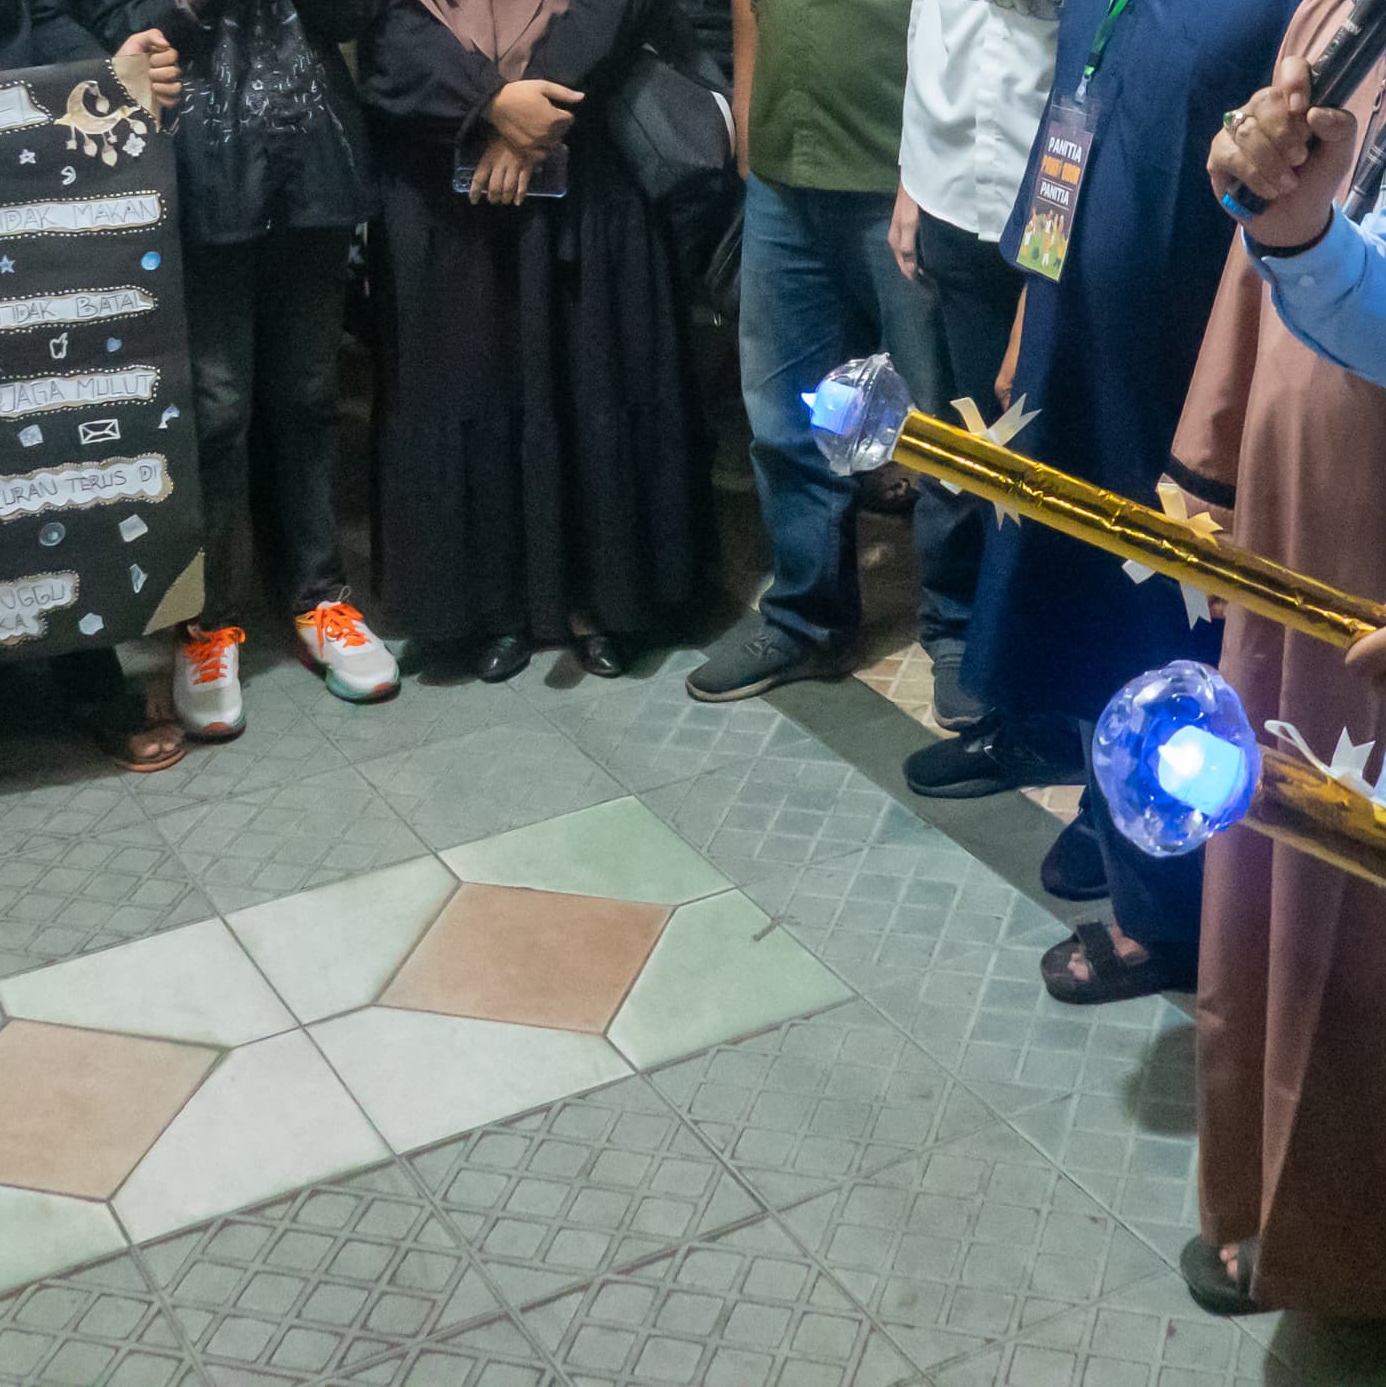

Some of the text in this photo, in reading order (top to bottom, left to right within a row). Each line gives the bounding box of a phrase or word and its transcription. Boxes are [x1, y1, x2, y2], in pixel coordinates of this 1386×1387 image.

[1048, 136, 1082, 163] PANITIA
[1039, 181, 1070, 206] PANITIA
[72, 199, 157, 228] MAKAN
[76, 291, 148, 317] BATAL
[0, 373, 154, 412] JAGA MULUT
[67, 469, 128, 494] TERUS
[140, 464, 159, 482] DI
